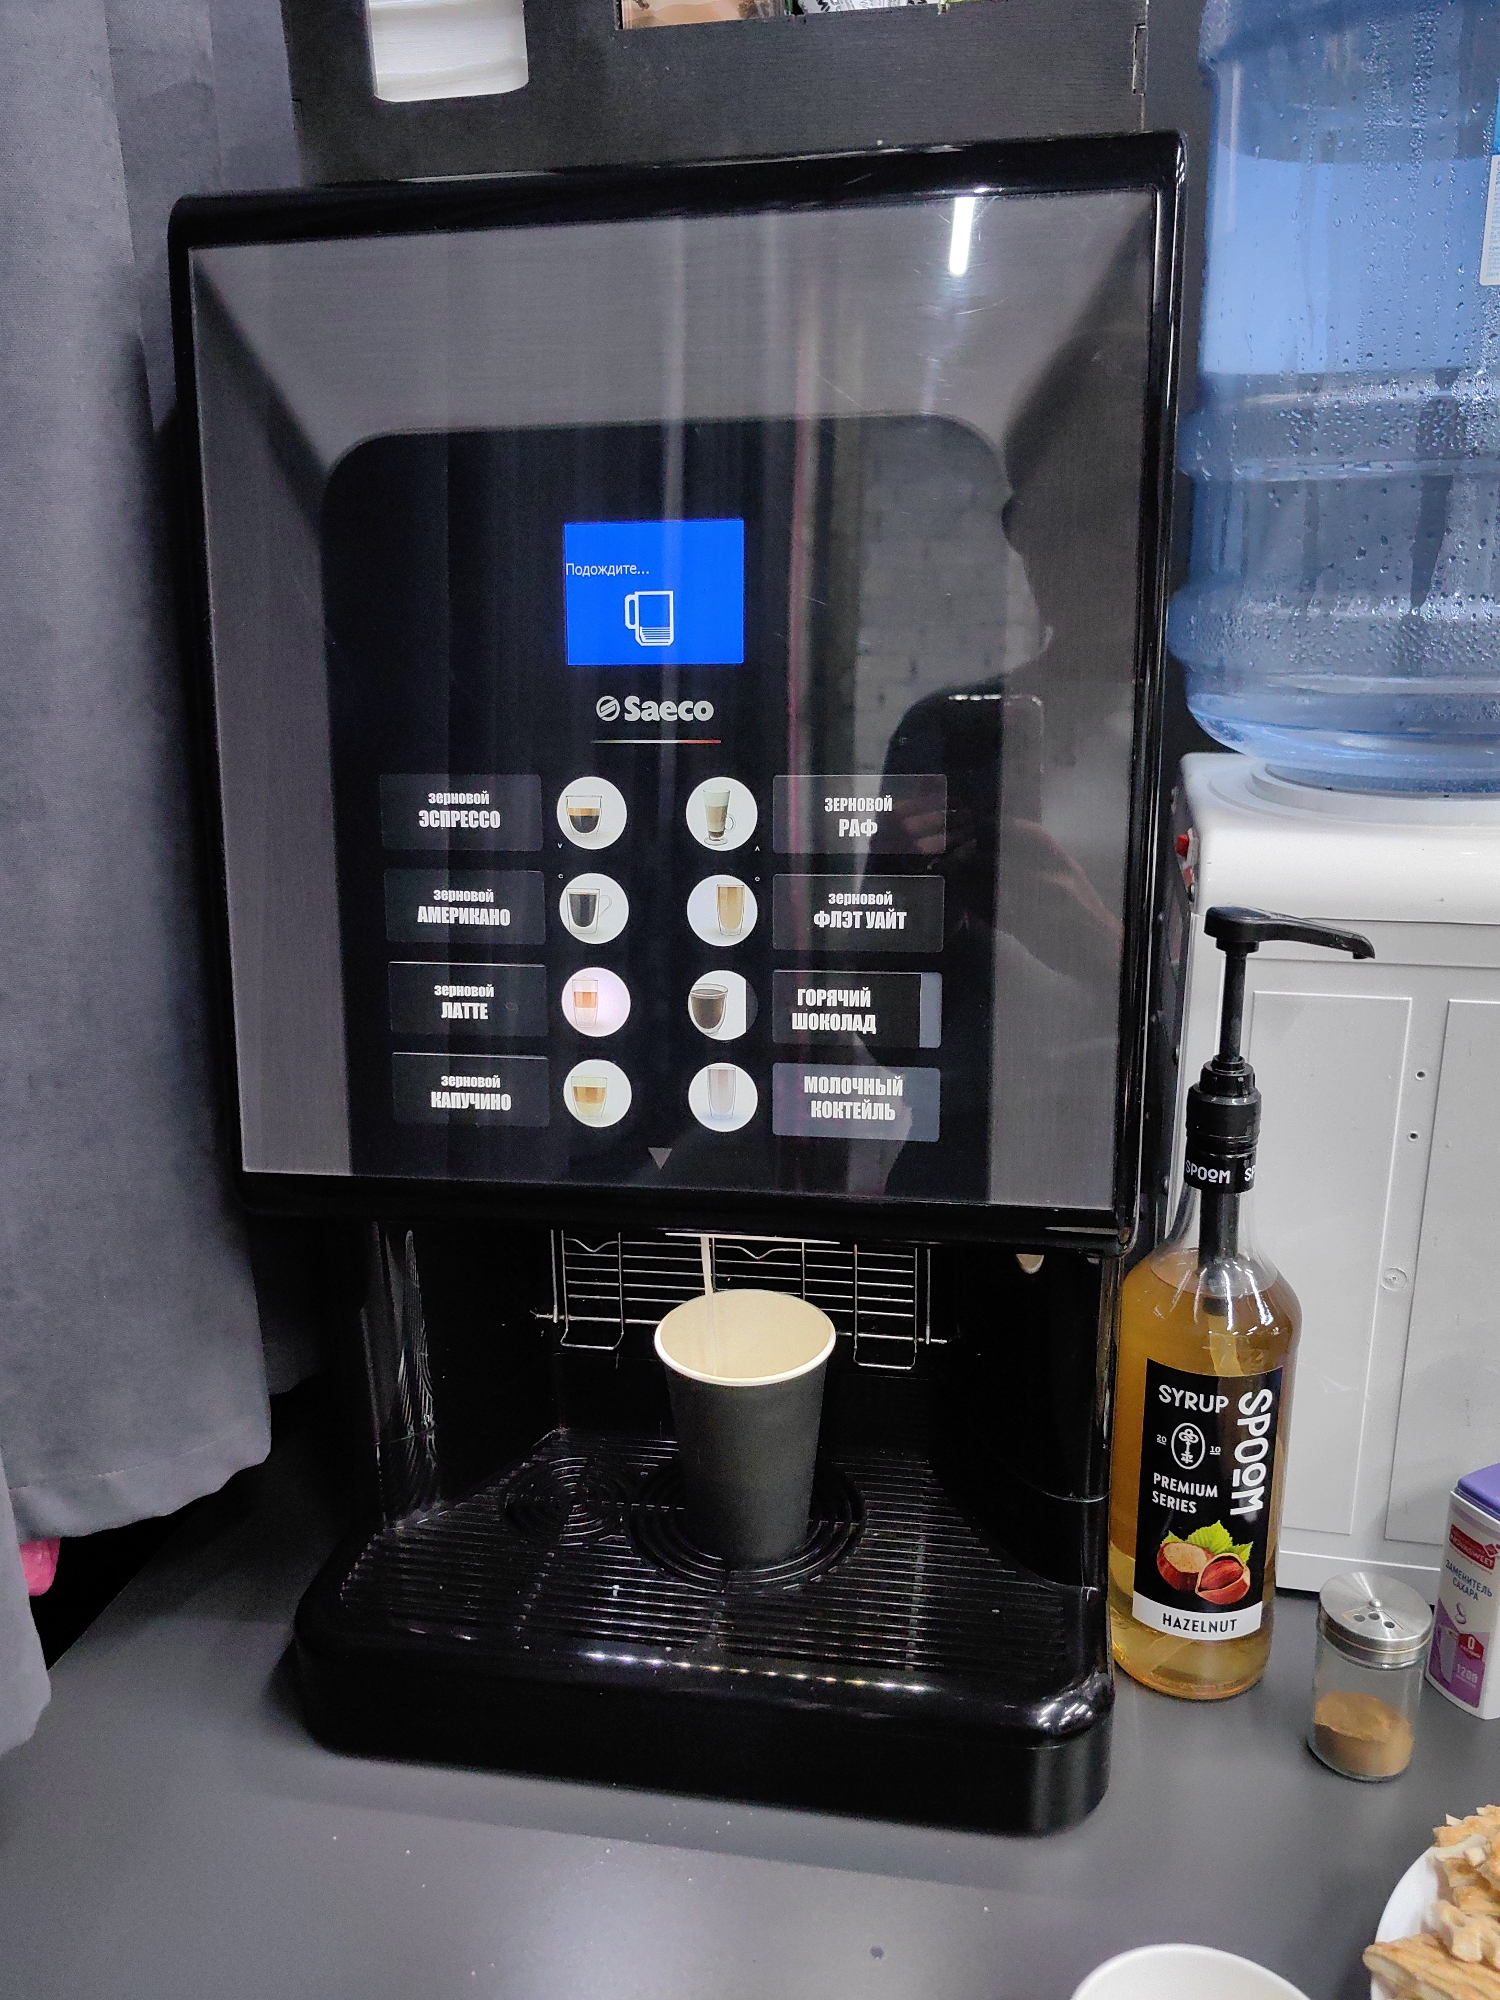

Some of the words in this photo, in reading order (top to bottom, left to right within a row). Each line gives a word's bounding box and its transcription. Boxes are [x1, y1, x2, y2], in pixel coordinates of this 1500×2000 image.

[565, 563, 650, 578] Подождите...
[624, 695, 714, 722] Saeco
[824, 795, 893, 813] ЗЕРНОВОЙ
[418, 810, 501, 829] ЭСПРЕССО
[838, 818, 878, 837] РАФ
[417, 906, 511, 926] АМЕРИКАНО
[813, 910, 863, 929] ФЛЭТ
[865, 909, 907, 931] УАЙТ
[797, 987, 871, 1008] ГОРЯЧИЙ
[441, 1002, 489, 1020] ЛАТТЕ
[791, 1012, 877, 1034] ШОКОЛАД
[803, 1075, 904, 1097] МОЛОЧНЫЙ
[430, 1091, 512, 1111] КАПУЧИНО
[810, 1099, 896, 1121] КОКТЕЙЛЬ
[1185, 1160, 1231, 1184] SPOOM
[1158, 1384, 1230, 1413] SYRUP
[1230, 1389, 1273, 1516] SPOOM
[1153, 1472, 1219, 1498] PREMIUM
[1152, 1490, 1197, 1514] SERIES
[1446, 1559, 1493, 1597] ЗАМЕНИТЕЛЬ
[1452, 1576, 1479, 1601] САХАРА
[1162, 1613, 1238, 1633] HAZELNUT
